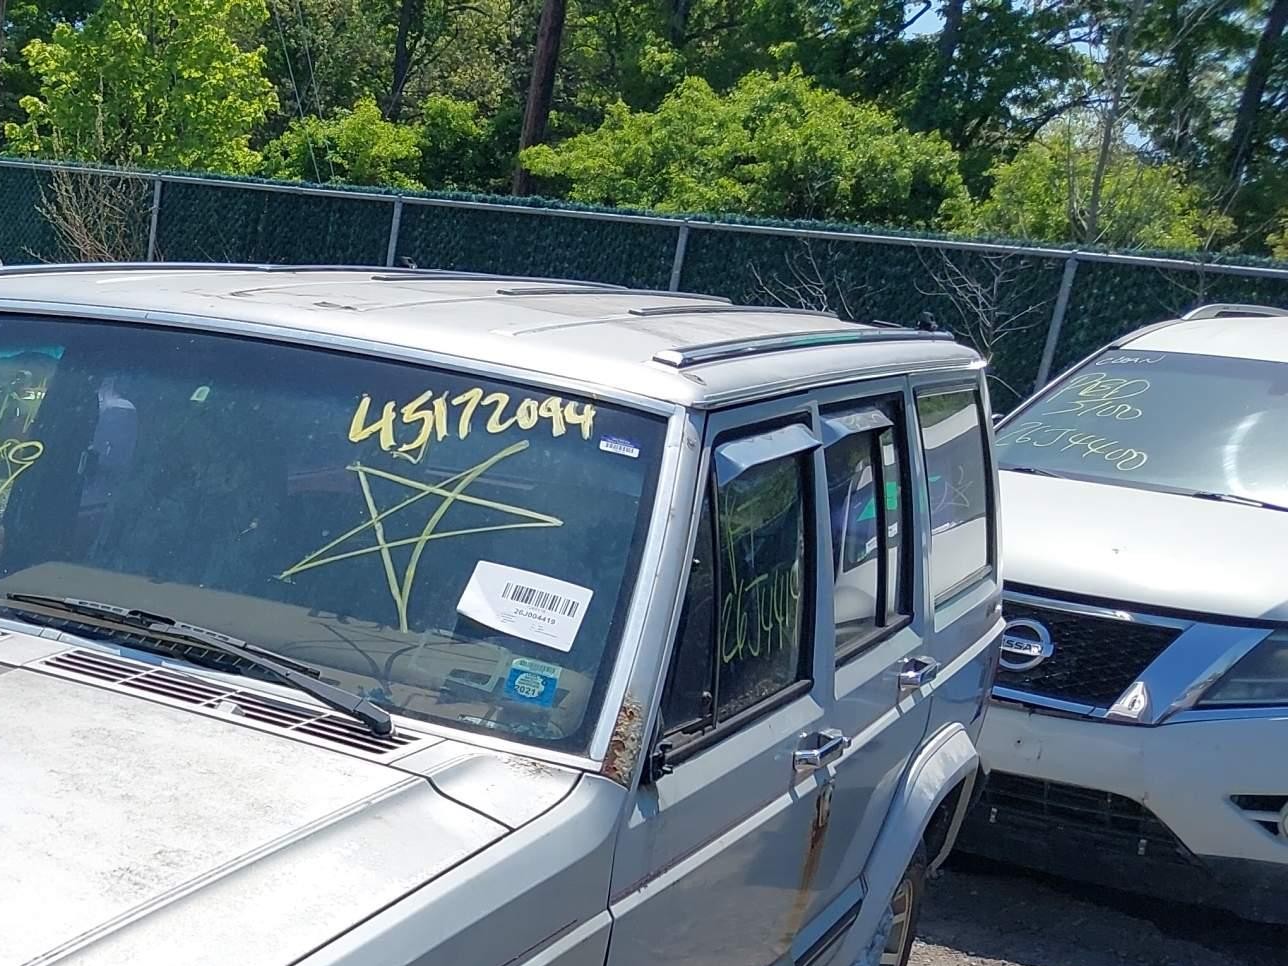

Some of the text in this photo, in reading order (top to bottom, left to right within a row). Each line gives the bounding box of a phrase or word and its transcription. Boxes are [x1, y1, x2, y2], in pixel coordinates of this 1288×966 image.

[348, 387, 596, 454] 45172094
[513, 608, 556, 625] 26J004419
[514, 684, 536, 697] 2021
